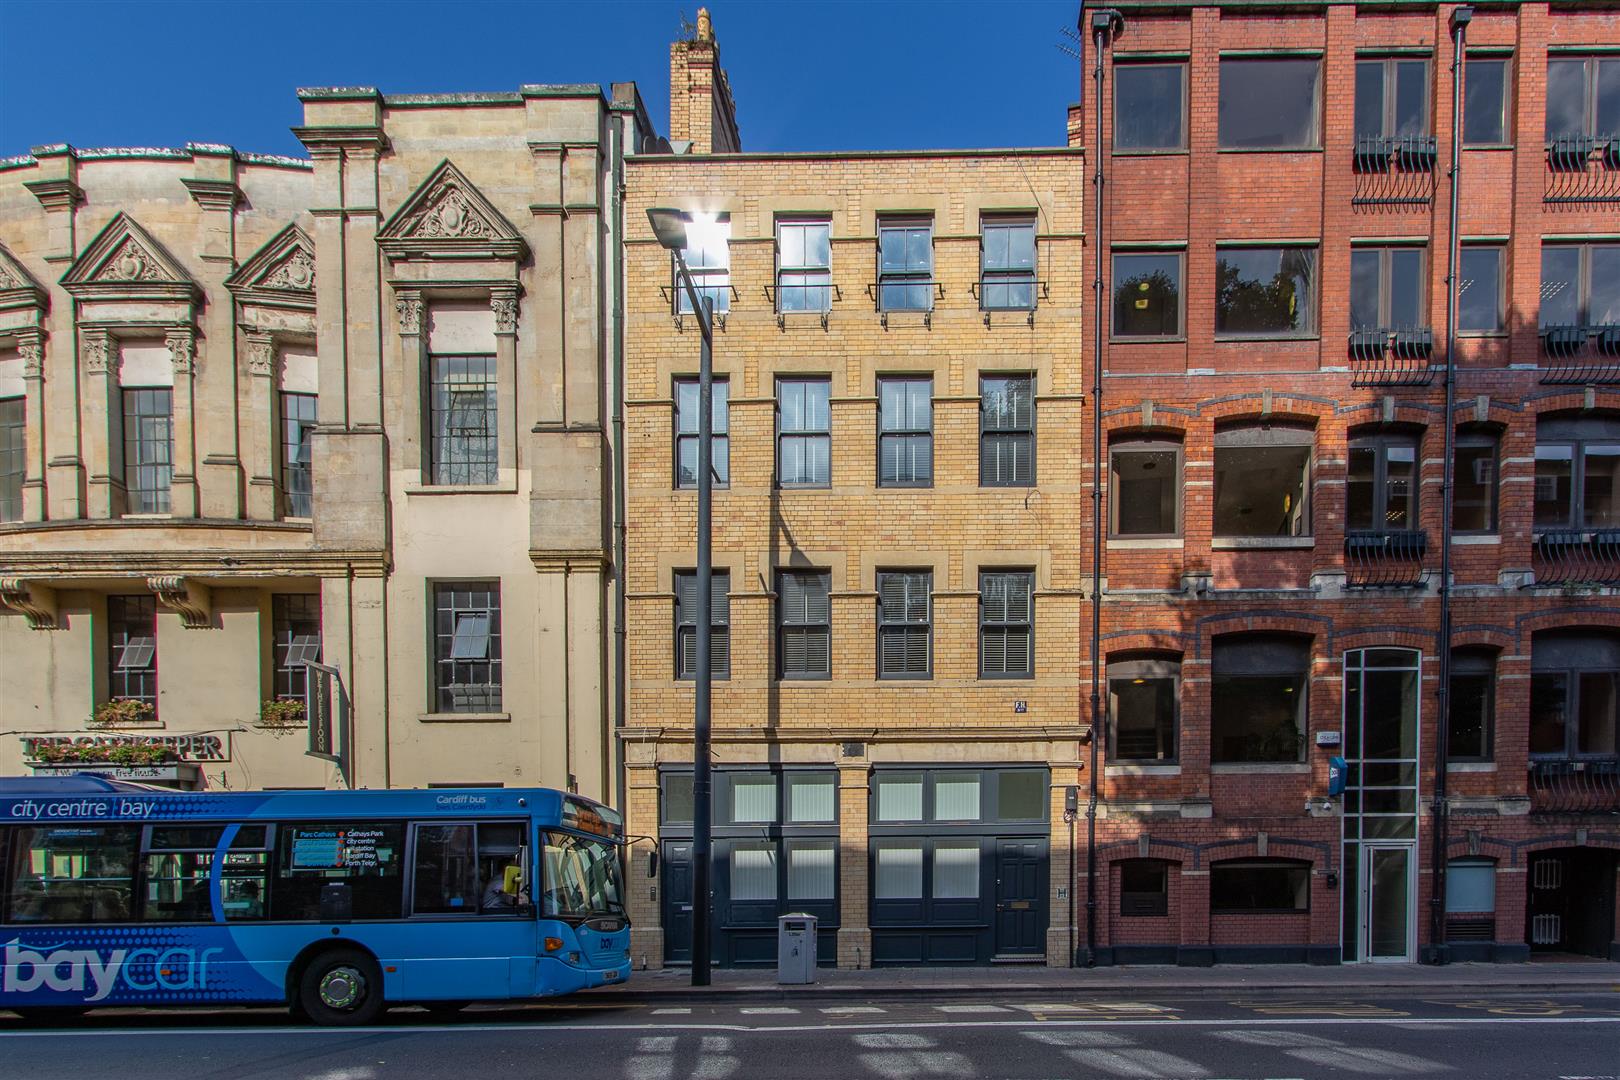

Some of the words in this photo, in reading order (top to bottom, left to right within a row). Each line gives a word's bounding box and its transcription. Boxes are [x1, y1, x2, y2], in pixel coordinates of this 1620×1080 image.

[436, 794, 467, 803] Cardiff
[469, 794, 486, 803] bus
[11, 799, 45, 820] city
[47, 799, 107, 816] centre
[119, 799, 155, 818] bay
